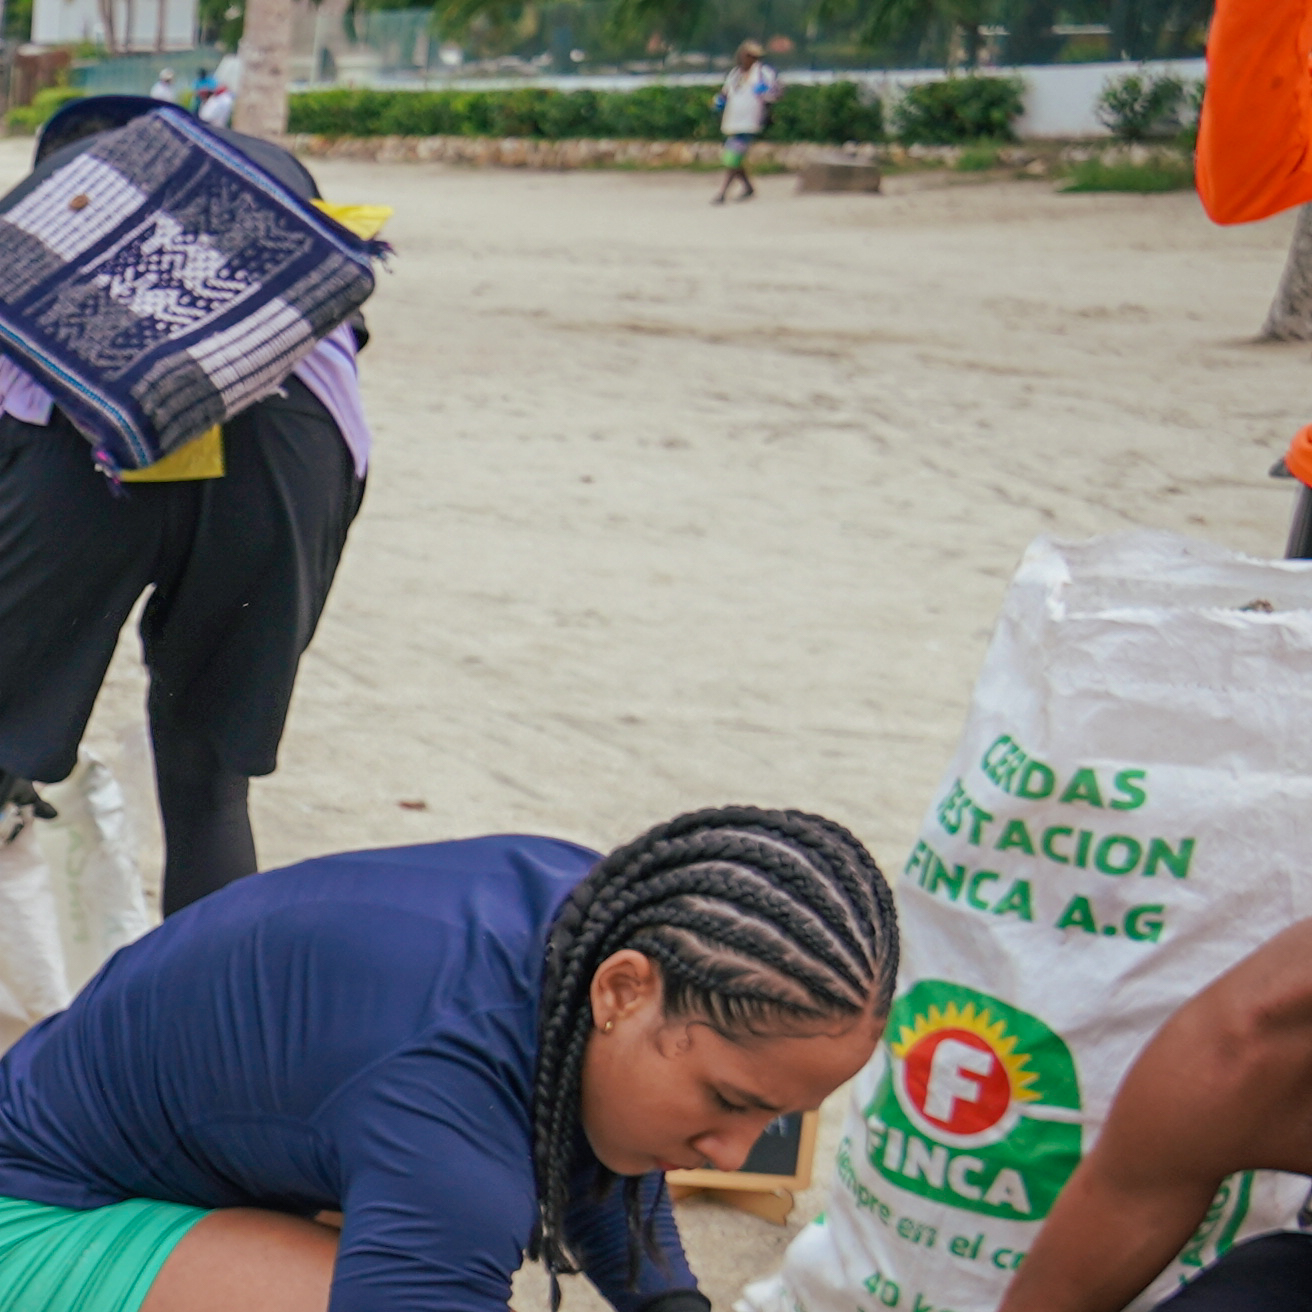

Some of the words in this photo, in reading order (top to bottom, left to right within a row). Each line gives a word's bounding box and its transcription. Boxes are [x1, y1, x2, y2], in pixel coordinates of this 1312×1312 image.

[981, 735, 1148, 812] CERDAS
[903, 839, 1034, 922] FINCA
[1055, 893, 1166, 943] A.G
[867, 1114, 1032, 1215] FINCA
[895, 1216, 938, 1248] en
[949, 1233, 985, 1261] el
